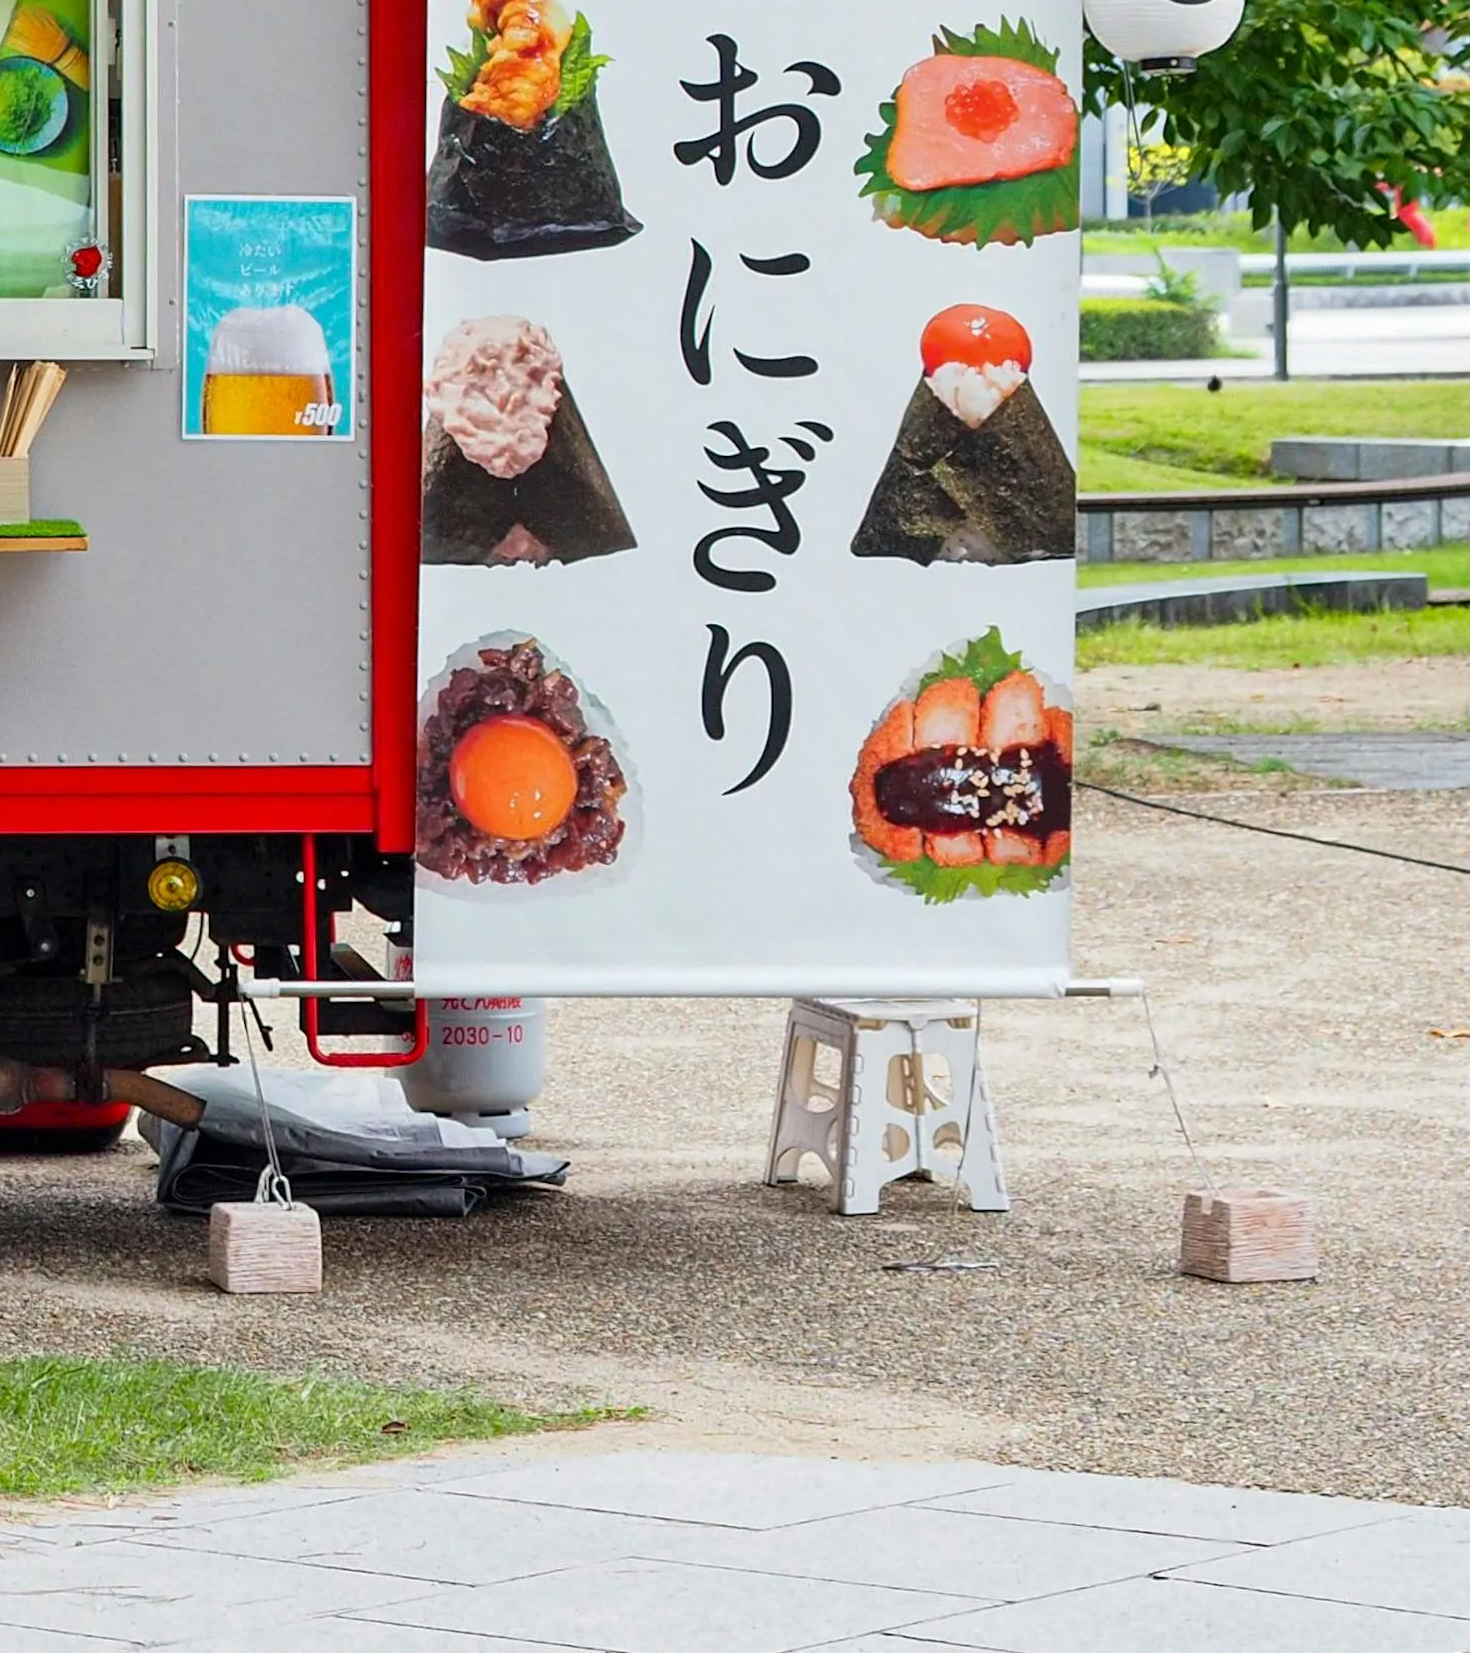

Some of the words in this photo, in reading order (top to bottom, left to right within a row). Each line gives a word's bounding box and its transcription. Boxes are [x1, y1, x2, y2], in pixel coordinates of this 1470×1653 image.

[293, 402, 343, 426] ¥500
[673, 33, 843, 796] おにぎり
[442, 1025, 523, 1046] 2030-10
